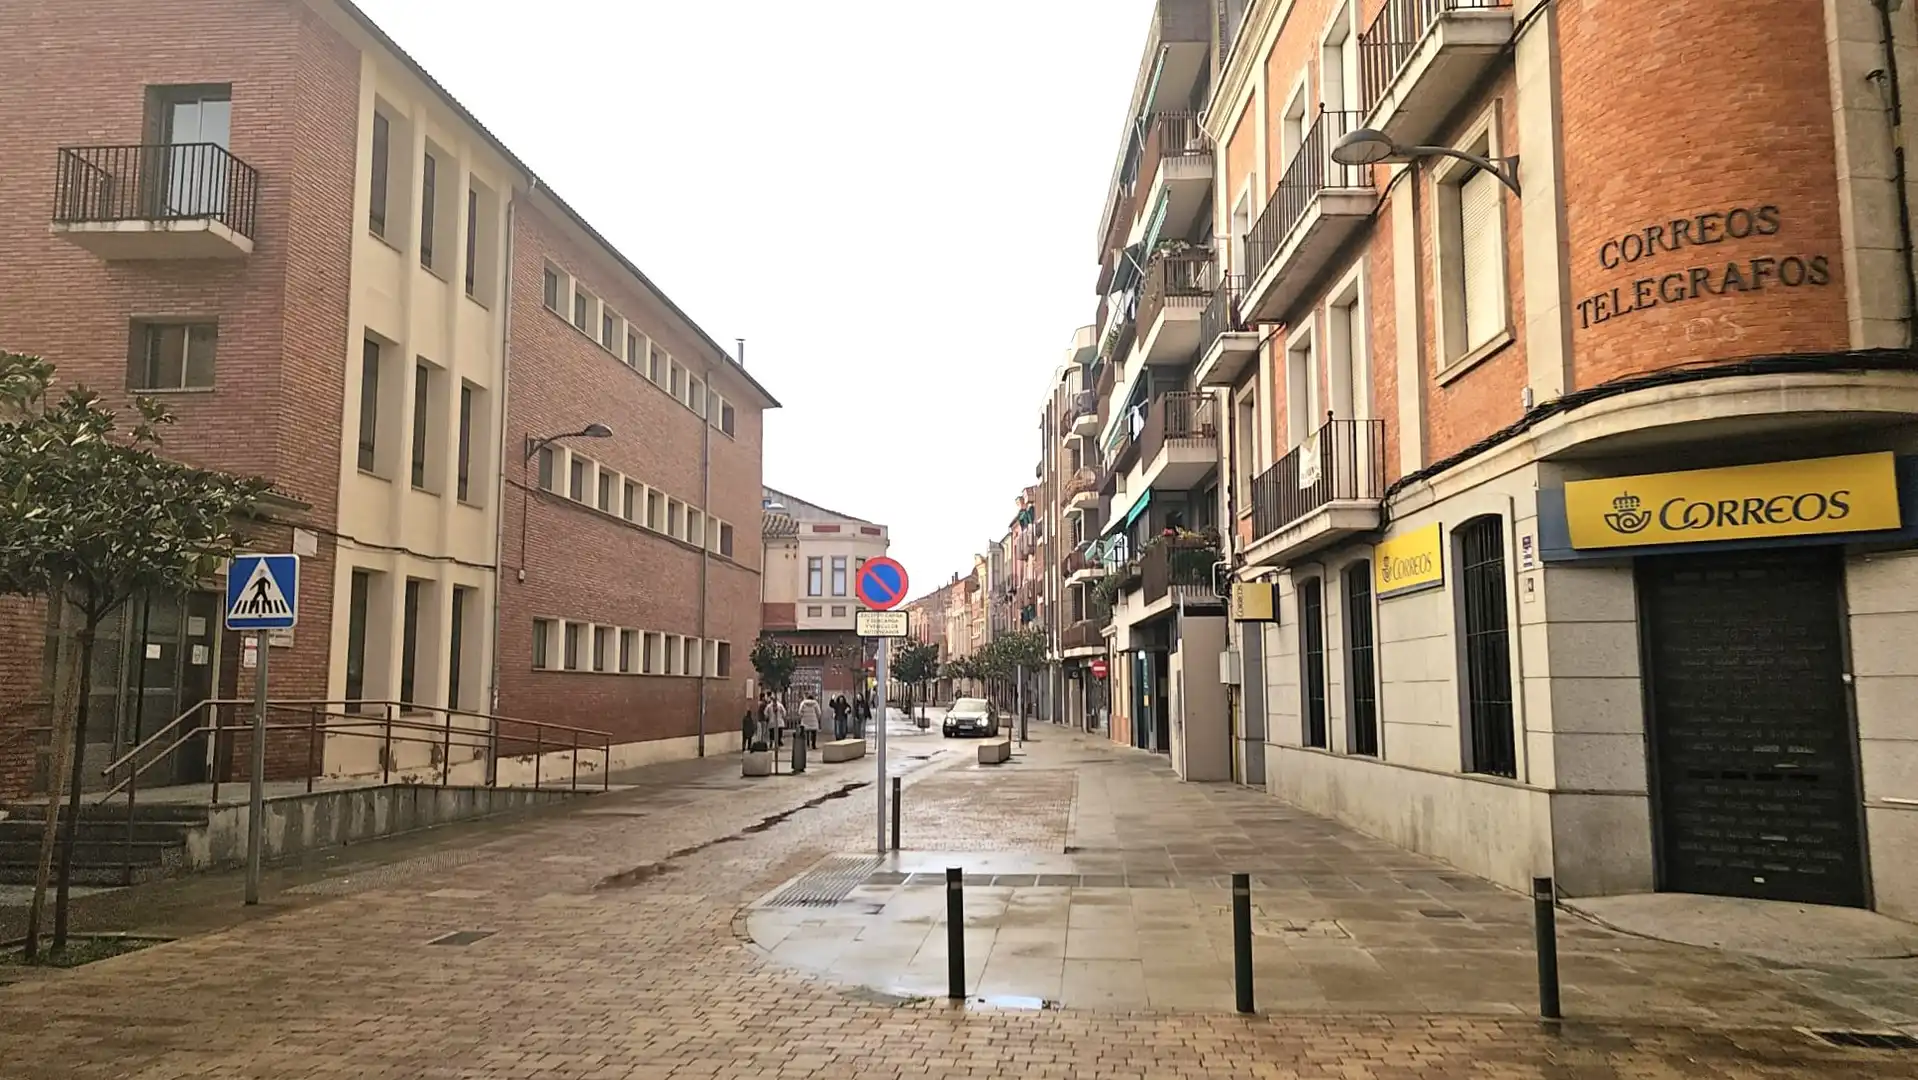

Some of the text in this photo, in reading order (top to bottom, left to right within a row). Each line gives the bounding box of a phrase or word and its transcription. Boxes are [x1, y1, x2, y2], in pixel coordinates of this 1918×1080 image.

[1600, 205, 1780, 270] CORREOS
[1576, 255, 1830, 330] TELEGRAFOS
[1659, 490, 1850, 532] CORREOS
